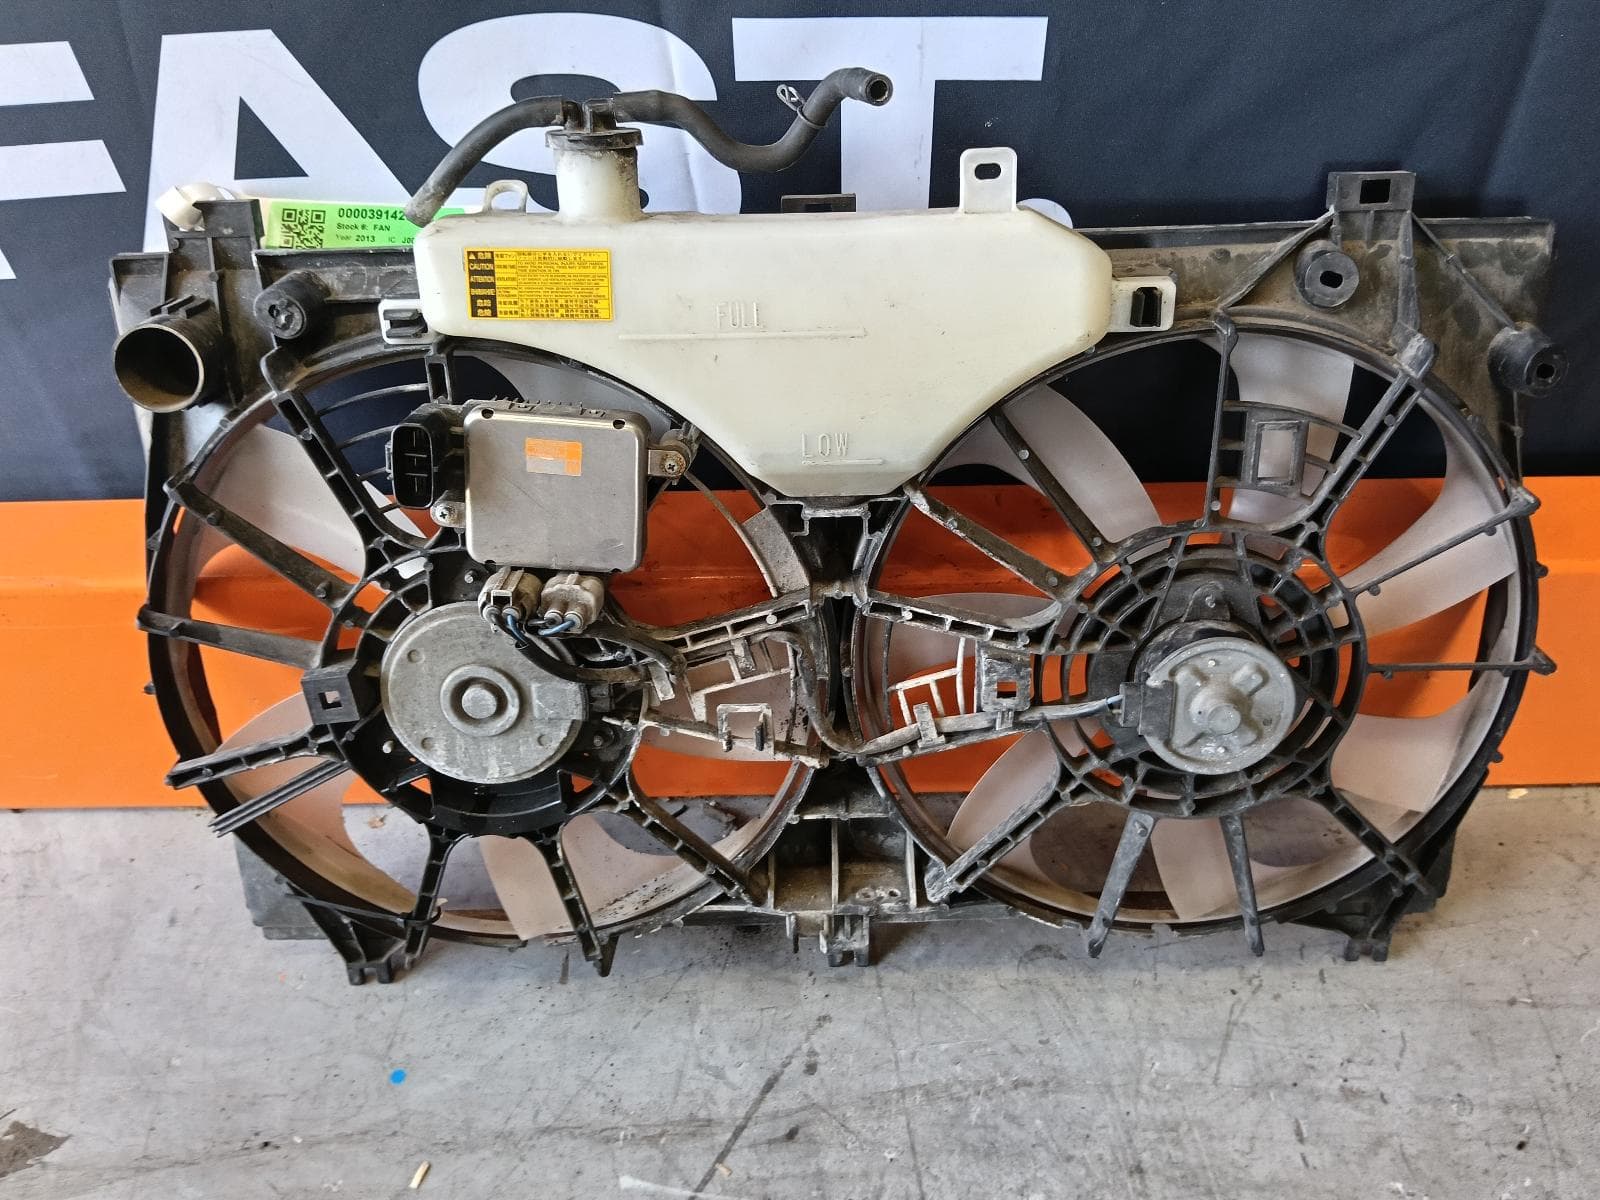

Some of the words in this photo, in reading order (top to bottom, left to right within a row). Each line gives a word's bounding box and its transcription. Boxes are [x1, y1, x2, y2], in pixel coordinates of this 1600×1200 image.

[0, 14, 1073, 280] FAST
[336, 222, 359, 231] Stock
[373, 224, 391, 232] FAN
[355, 234, 376, 243] 2013
[800, 432, 849, 458] LOW
